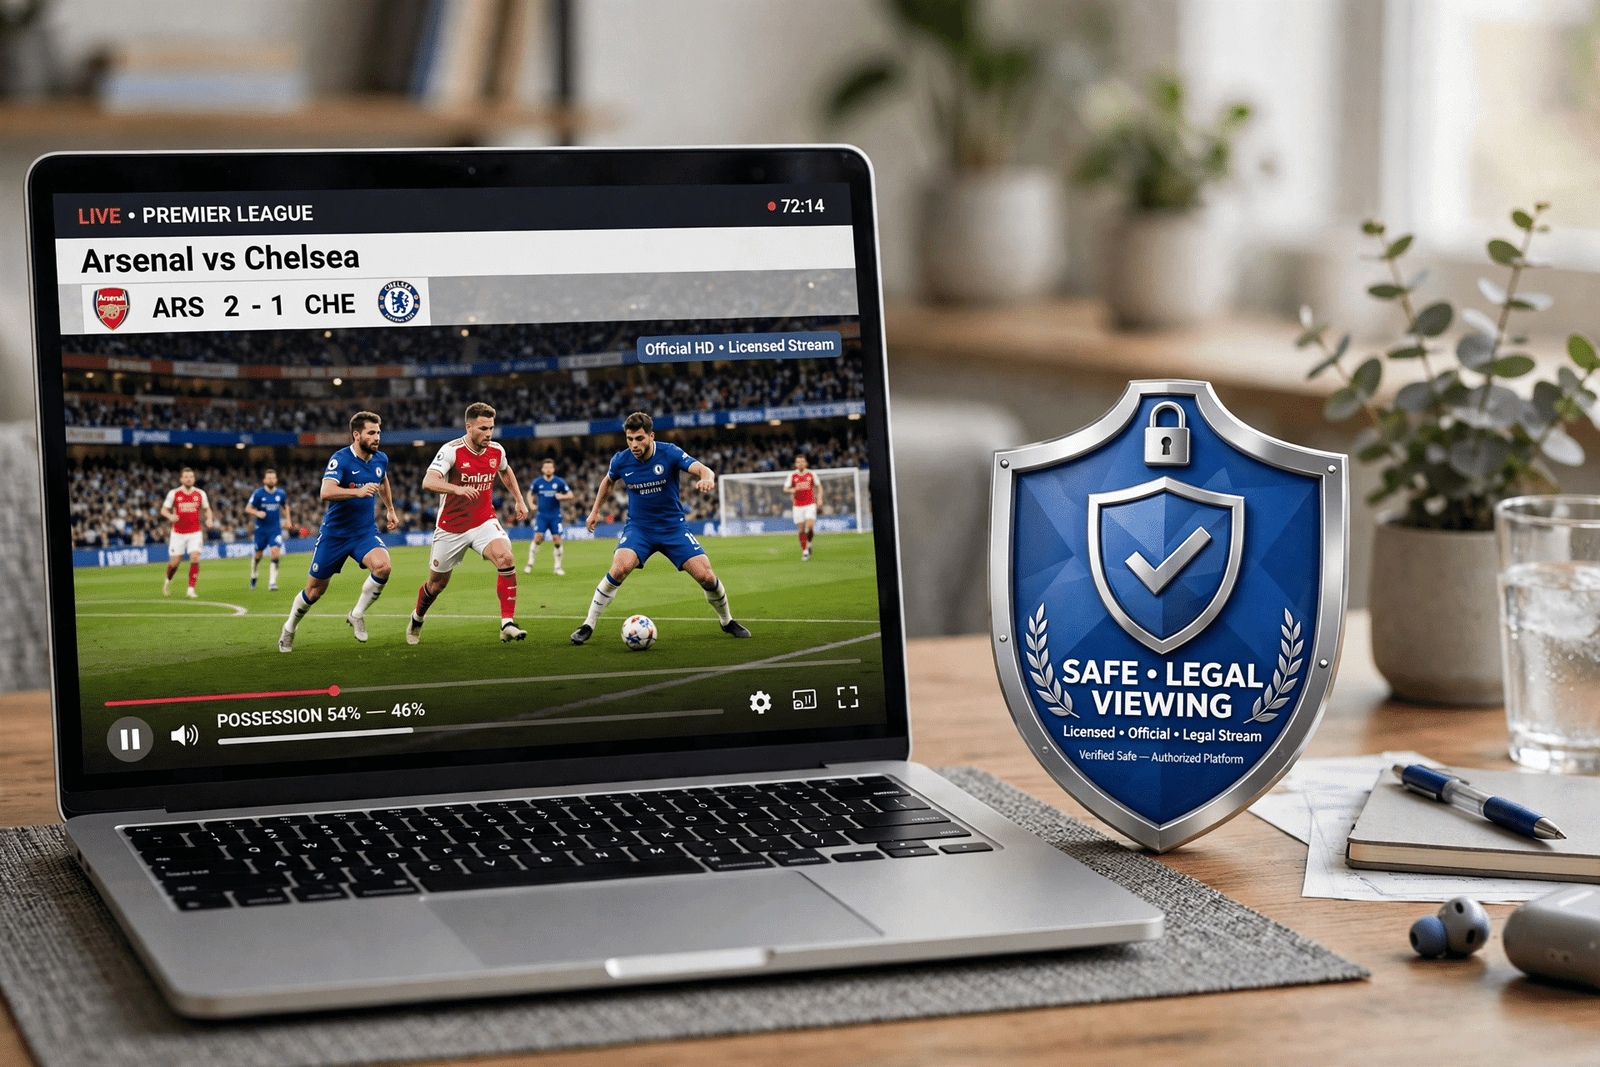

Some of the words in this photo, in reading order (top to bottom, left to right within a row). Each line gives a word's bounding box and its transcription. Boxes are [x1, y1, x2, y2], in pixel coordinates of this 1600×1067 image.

[79, 208, 121, 224] LIVE
[143, 207, 231, 223] PREMIER
[237, 205, 313, 222] LEAGUE
[781, 199, 824, 212] 72:14
[82, 246, 193, 273] Arsenal
[202, 252, 235, 270] vs
[245, 244, 359, 270] Chelsea
[153, 297, 204, 318] ARS
[224, 295, 239, 316] 2
[272, 295, 281, 315] 1
[305, 294, 355, 314] CHE
[646, 342, 691, 355] Official
[695, 342, 714, 354] HD
[729, 339, 785, 353] Licensed
[788, 340, 834, 351] Stream
[1063, 659, 1138, 684] SAFE
[1167, 662, 1263, 688] LEGAL
[1092, 690, 1231, 718] VIEWING
[218, 708, 322, 727] POSSESSION
[328, 706, 360, 721] 54%
[392, 703, 425, 717] 46%
[1064, 725, 1115, 738] Licensed
[1128, 727, 1170, 739] Official
[1184, 729, 1215, 743] Legal
[1219, 730, 1261, 741] Stream
[1079, 750, 1114, 760] Verified
[1117, 751, 1137, 761] Safe
[1151, 752, 1201, 763] Authorized
[1204, 753, 1243, 763] Platform
